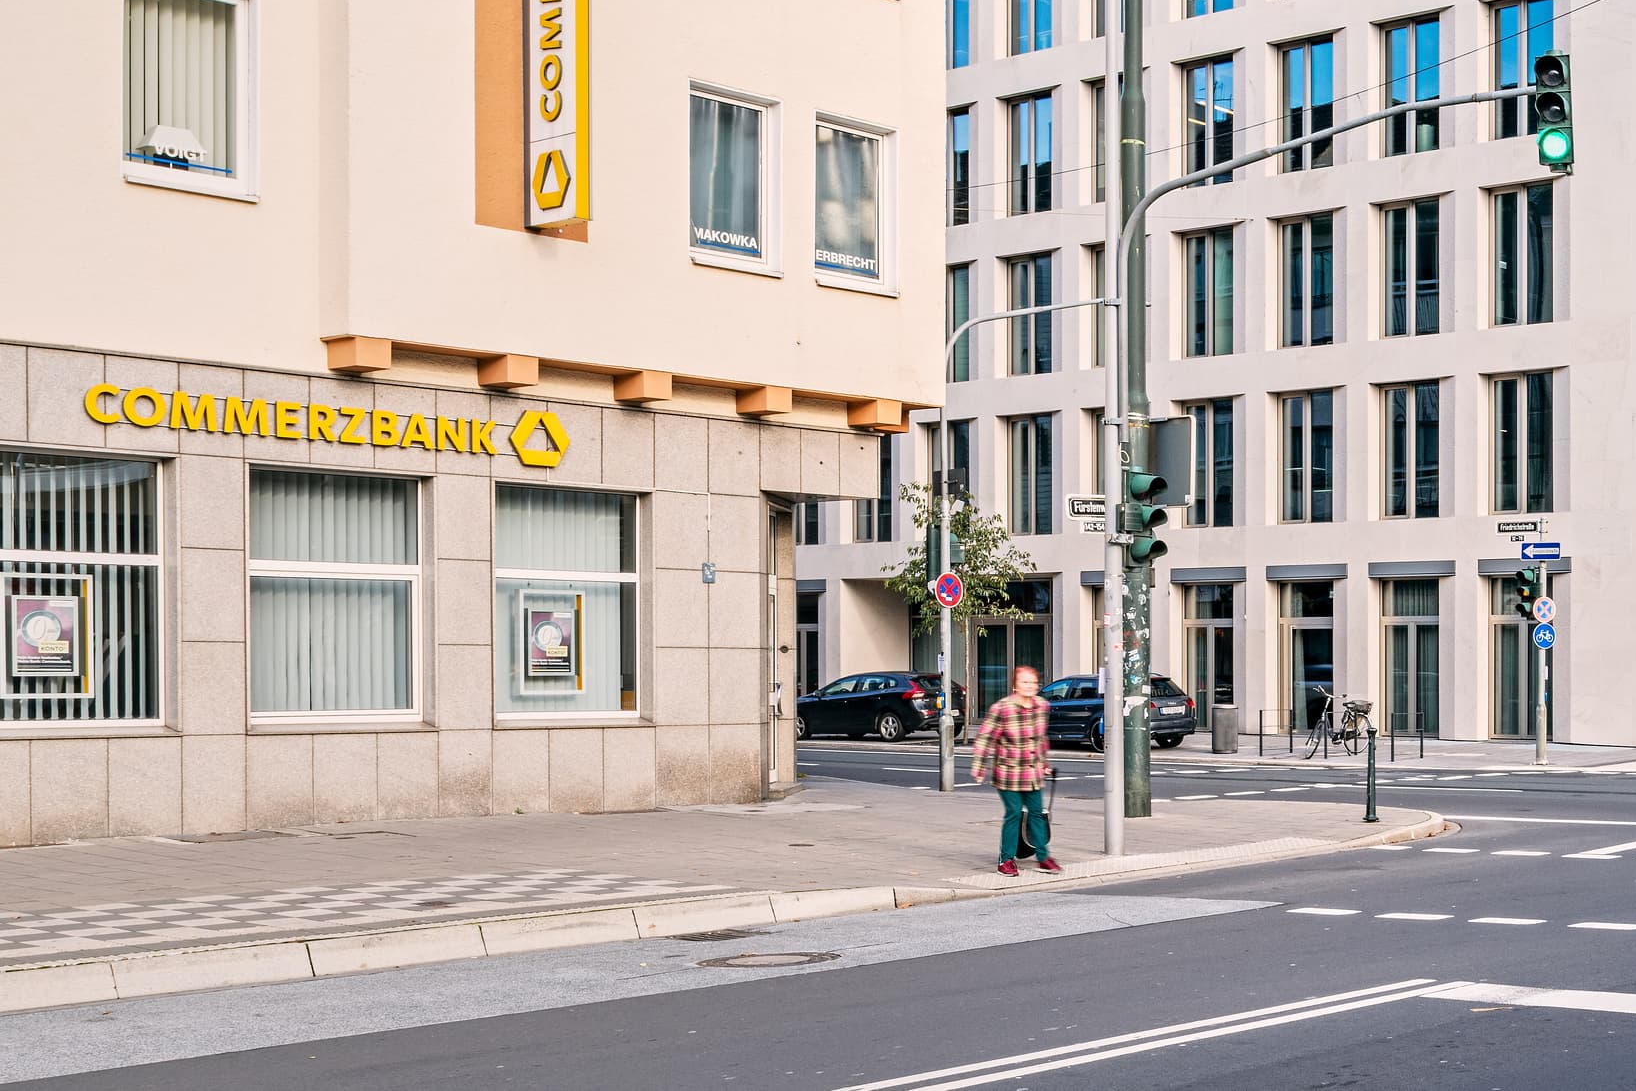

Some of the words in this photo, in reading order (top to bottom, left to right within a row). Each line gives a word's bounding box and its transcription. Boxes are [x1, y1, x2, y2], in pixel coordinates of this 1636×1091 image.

[154, 143, 207, 162] VOIGT
[694, 227, 758, 249] MAKOWKA
[816, 250, 876, 271] ERBRECHT
[84, 382, 498, 456] COMMERZBANK
[1074, 501, 1105, 513] Fürstenw
